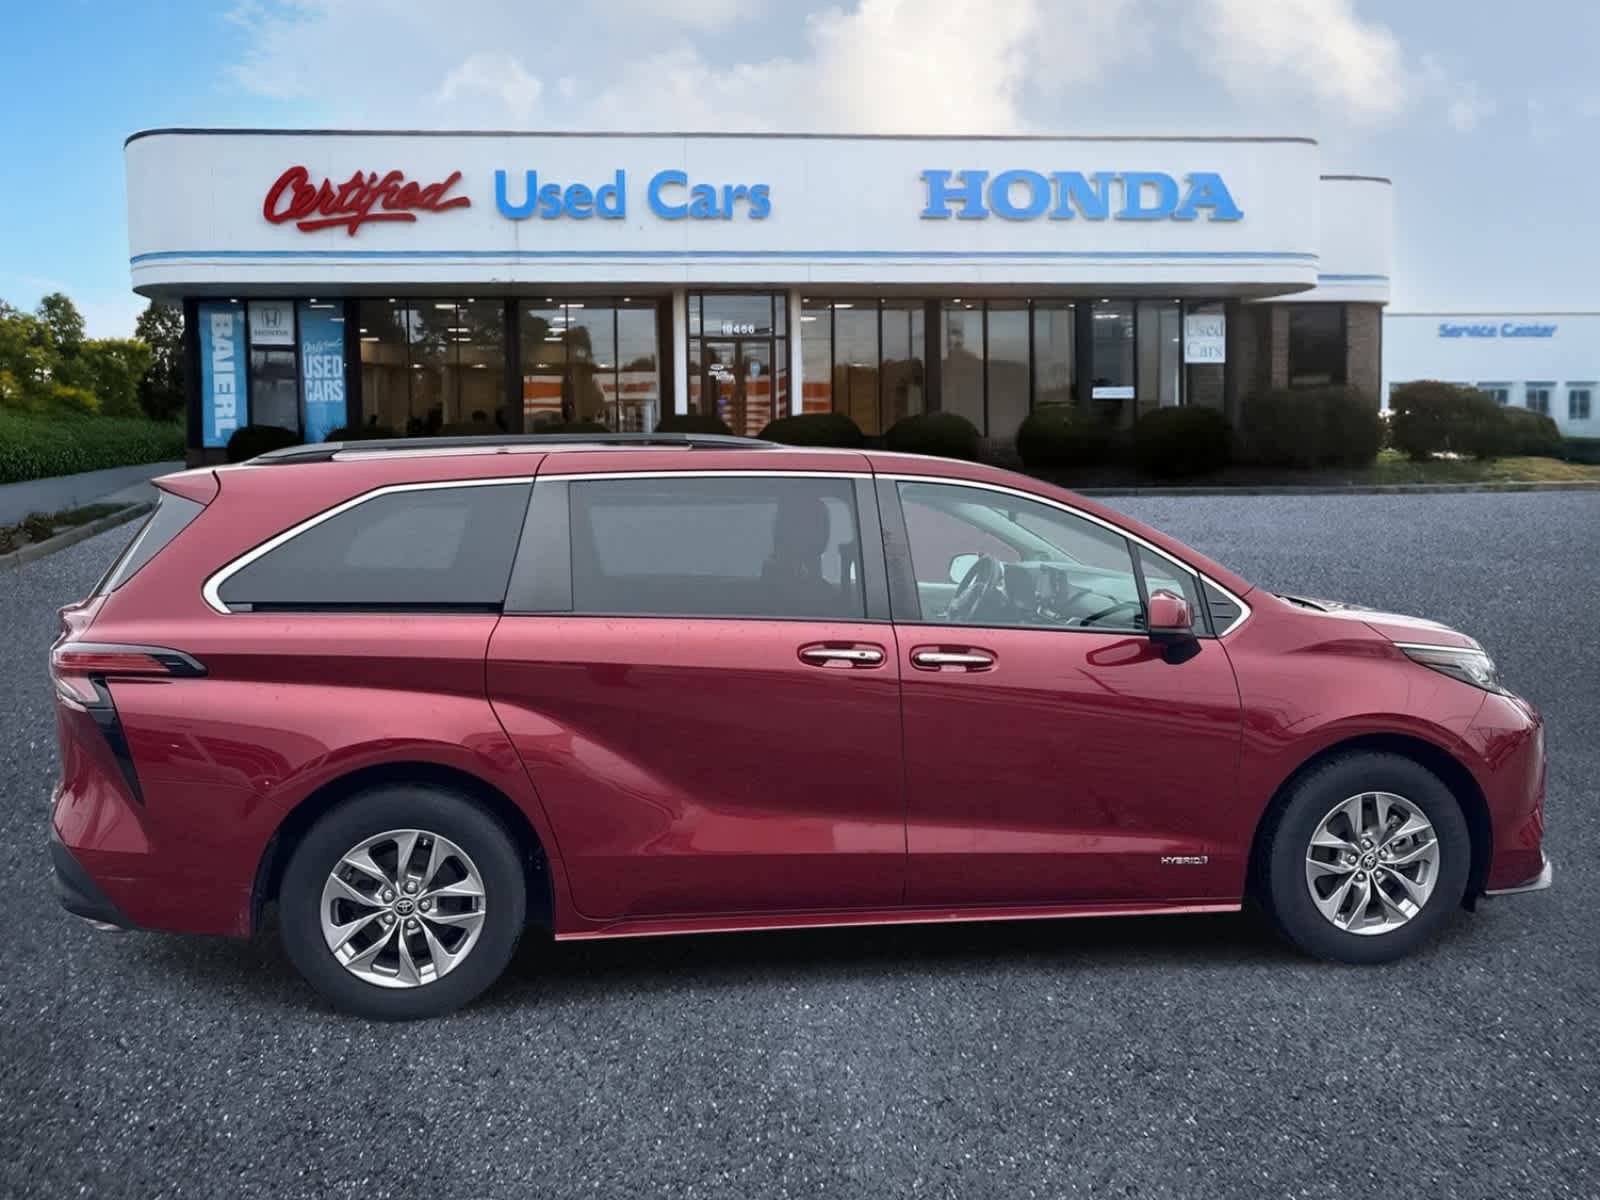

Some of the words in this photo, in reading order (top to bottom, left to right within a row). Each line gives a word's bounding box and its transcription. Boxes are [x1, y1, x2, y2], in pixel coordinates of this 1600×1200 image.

[262, 165, 471, 237] Certified
[494, 168, 627, 221] Used
[647, 169, 772, 221] Cars
[919, 169, 1245, 222] HONDA
[1186, 319, 1224, 337] Used
[1438, 323, 1497, 338] Service
[1500, 323, 1558, 338] Center
[1186, 341, 1224, 358] Cars
[212, 313, 237, 437] BAIERL
[303, 354, 343, 379] USED
[304, 379, 343, 401] CARS
[1160, 856, 1201, 865] HYBRID
